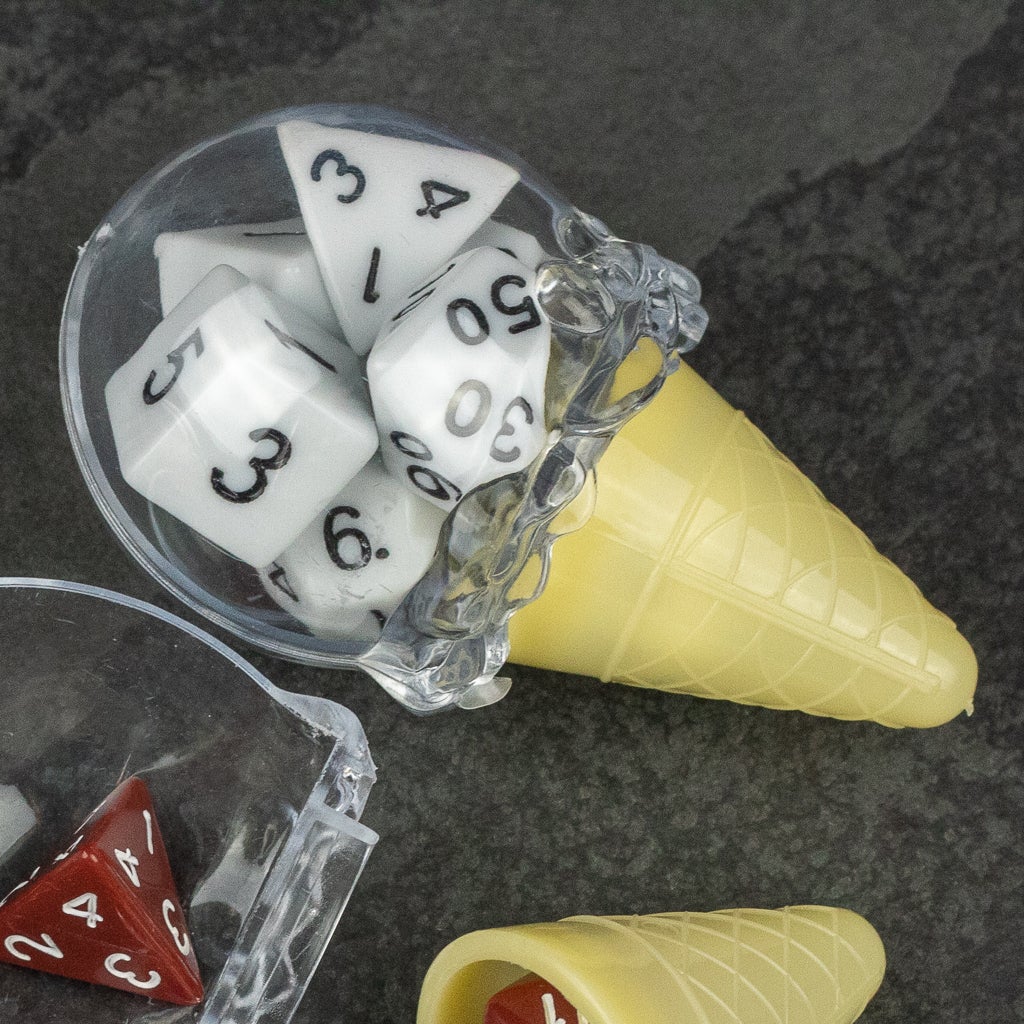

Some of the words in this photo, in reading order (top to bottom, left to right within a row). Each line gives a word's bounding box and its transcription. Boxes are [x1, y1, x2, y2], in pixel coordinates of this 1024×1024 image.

[311, 149, 366, 203] 3
[416, 180, 470, 219] 4
[142, 326, 205, 405] 5
[211, 427, 292, 504] 3
[114, 848, 140, 888] 4
[62, 892, 104, 929] 4
[162, 898, 190, 956] 3
[4, 933, 64, 962] 2
[104, 953, 162, 990] 3
